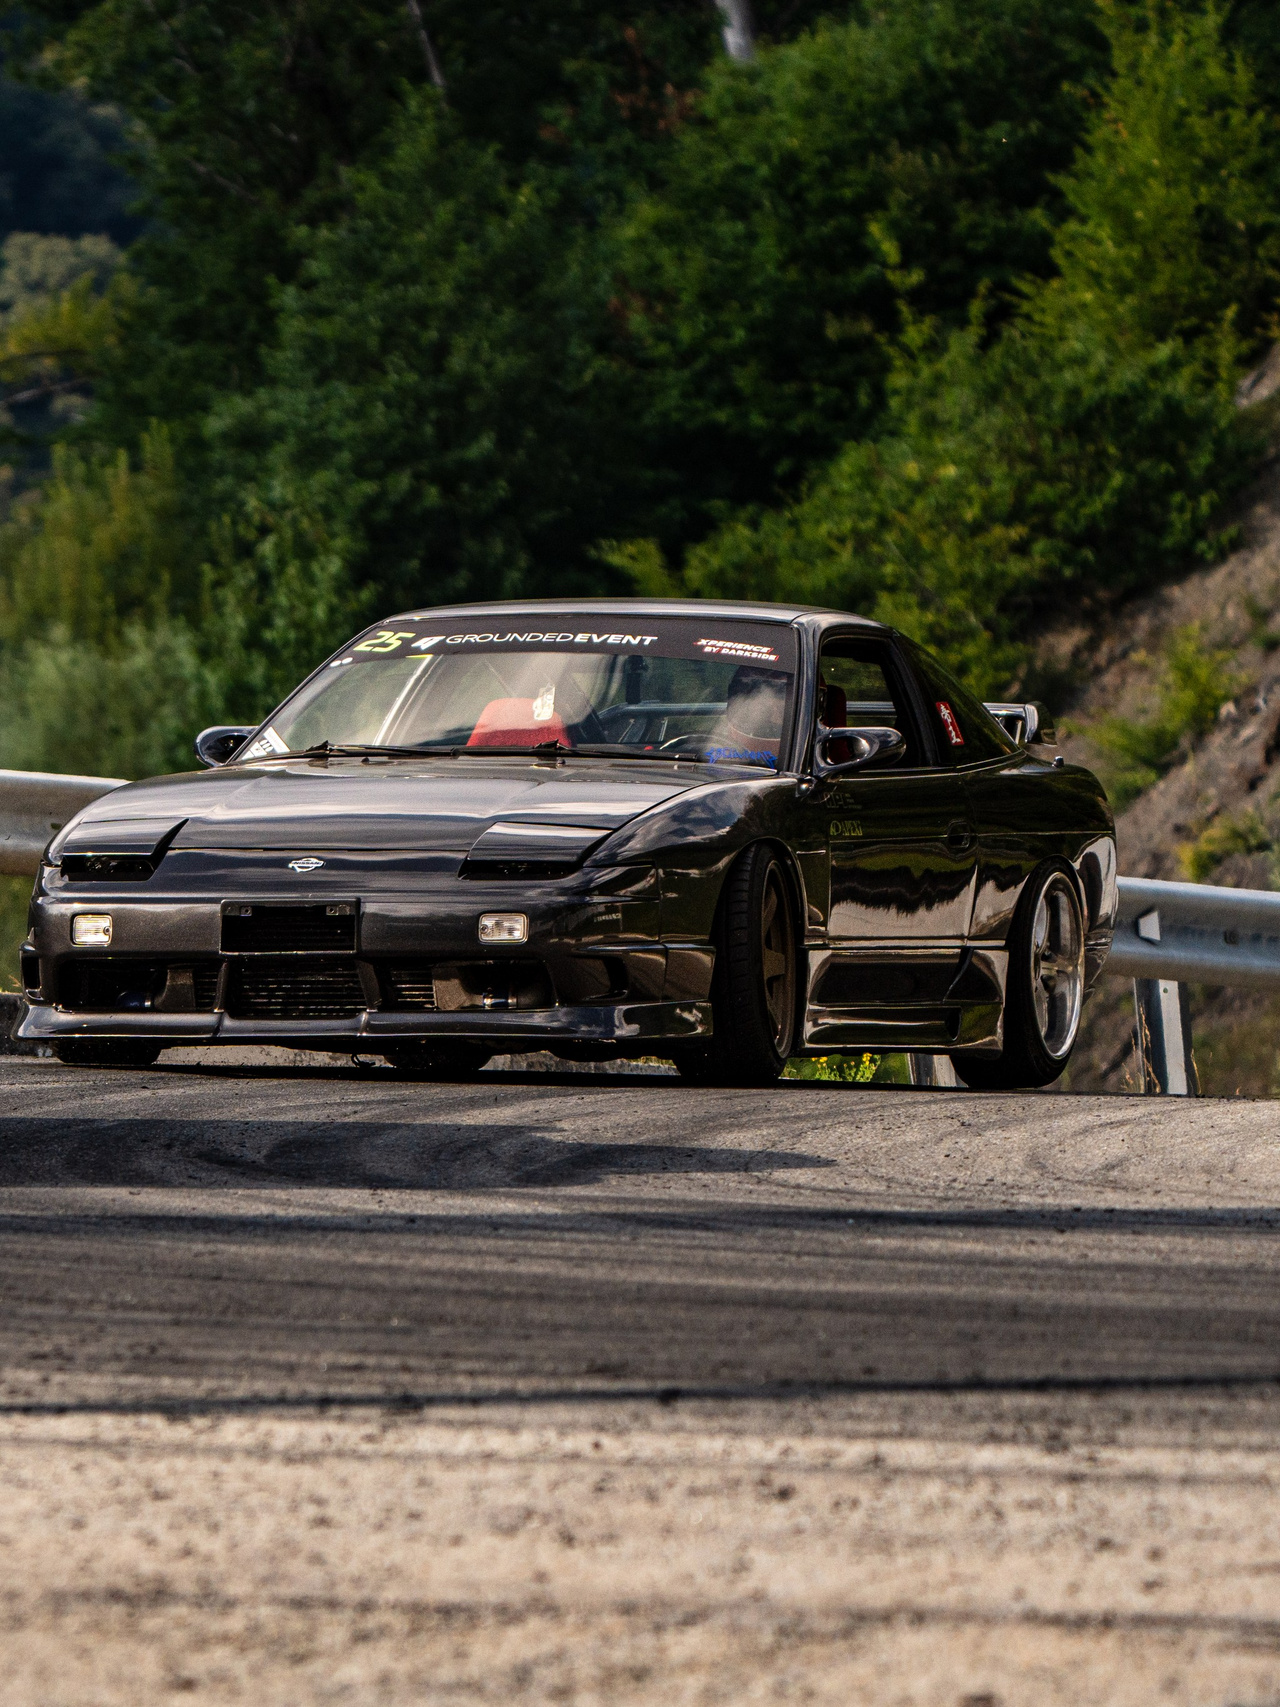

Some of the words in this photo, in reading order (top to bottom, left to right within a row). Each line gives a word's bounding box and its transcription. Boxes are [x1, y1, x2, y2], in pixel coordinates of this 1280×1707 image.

[353, 630, 416, 653] 25
[697, 638, 771, 653] XPERIENCE
[703, 645, 720, 653] BY
[721, 647, 777, 661] DARKSIDE
